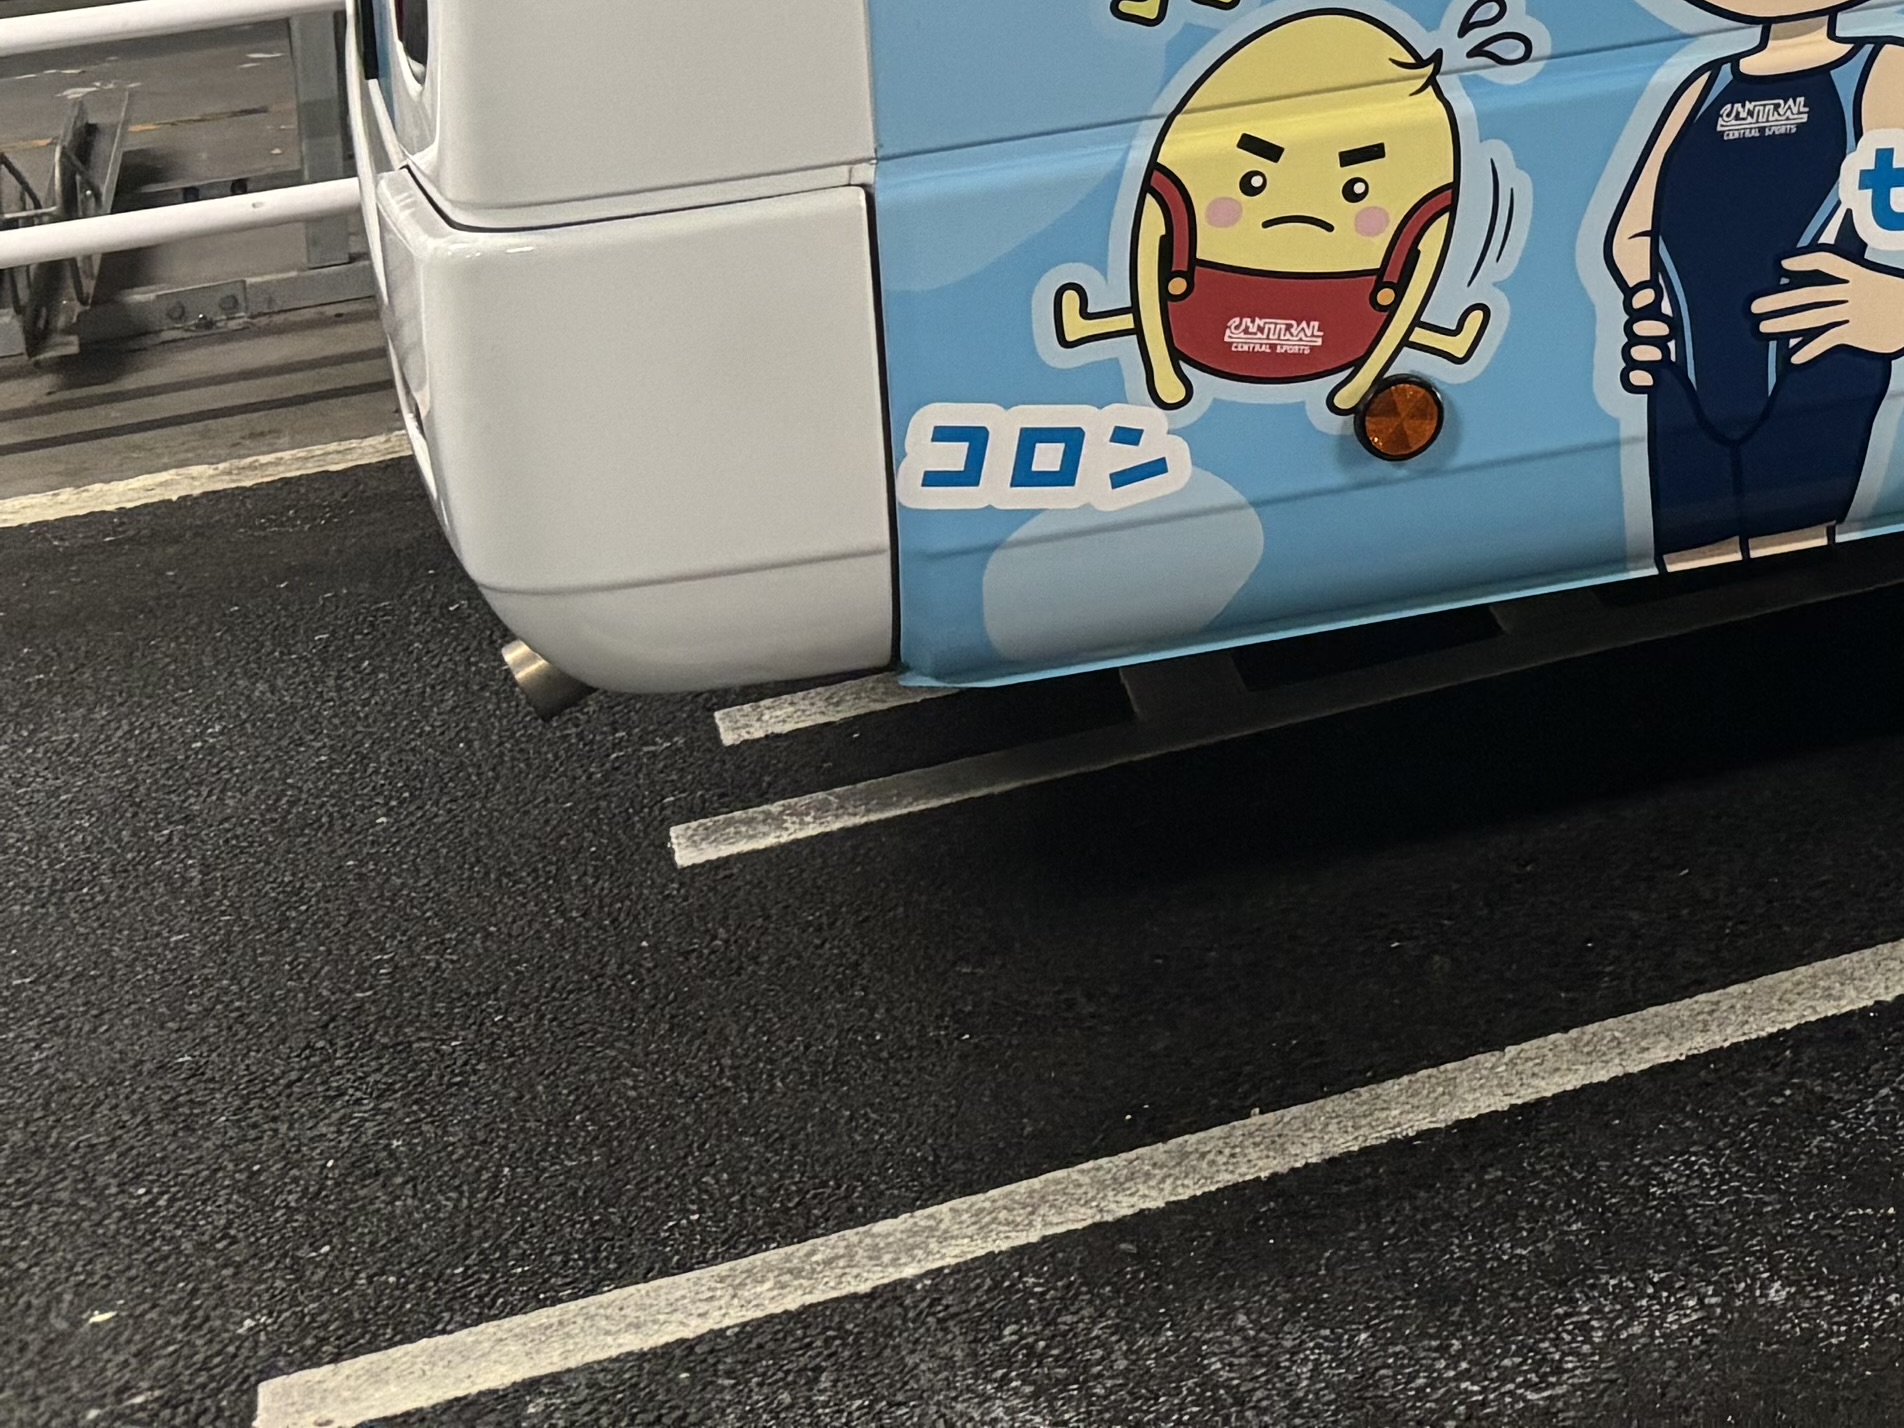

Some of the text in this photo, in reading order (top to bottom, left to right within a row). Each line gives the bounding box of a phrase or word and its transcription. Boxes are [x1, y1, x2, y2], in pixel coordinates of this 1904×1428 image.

[1716, 96, 1810, 132] CENTRAL
[1224, 316, 1324, 346] CENTRAL
[920, 425, 1169, 490] コロン
